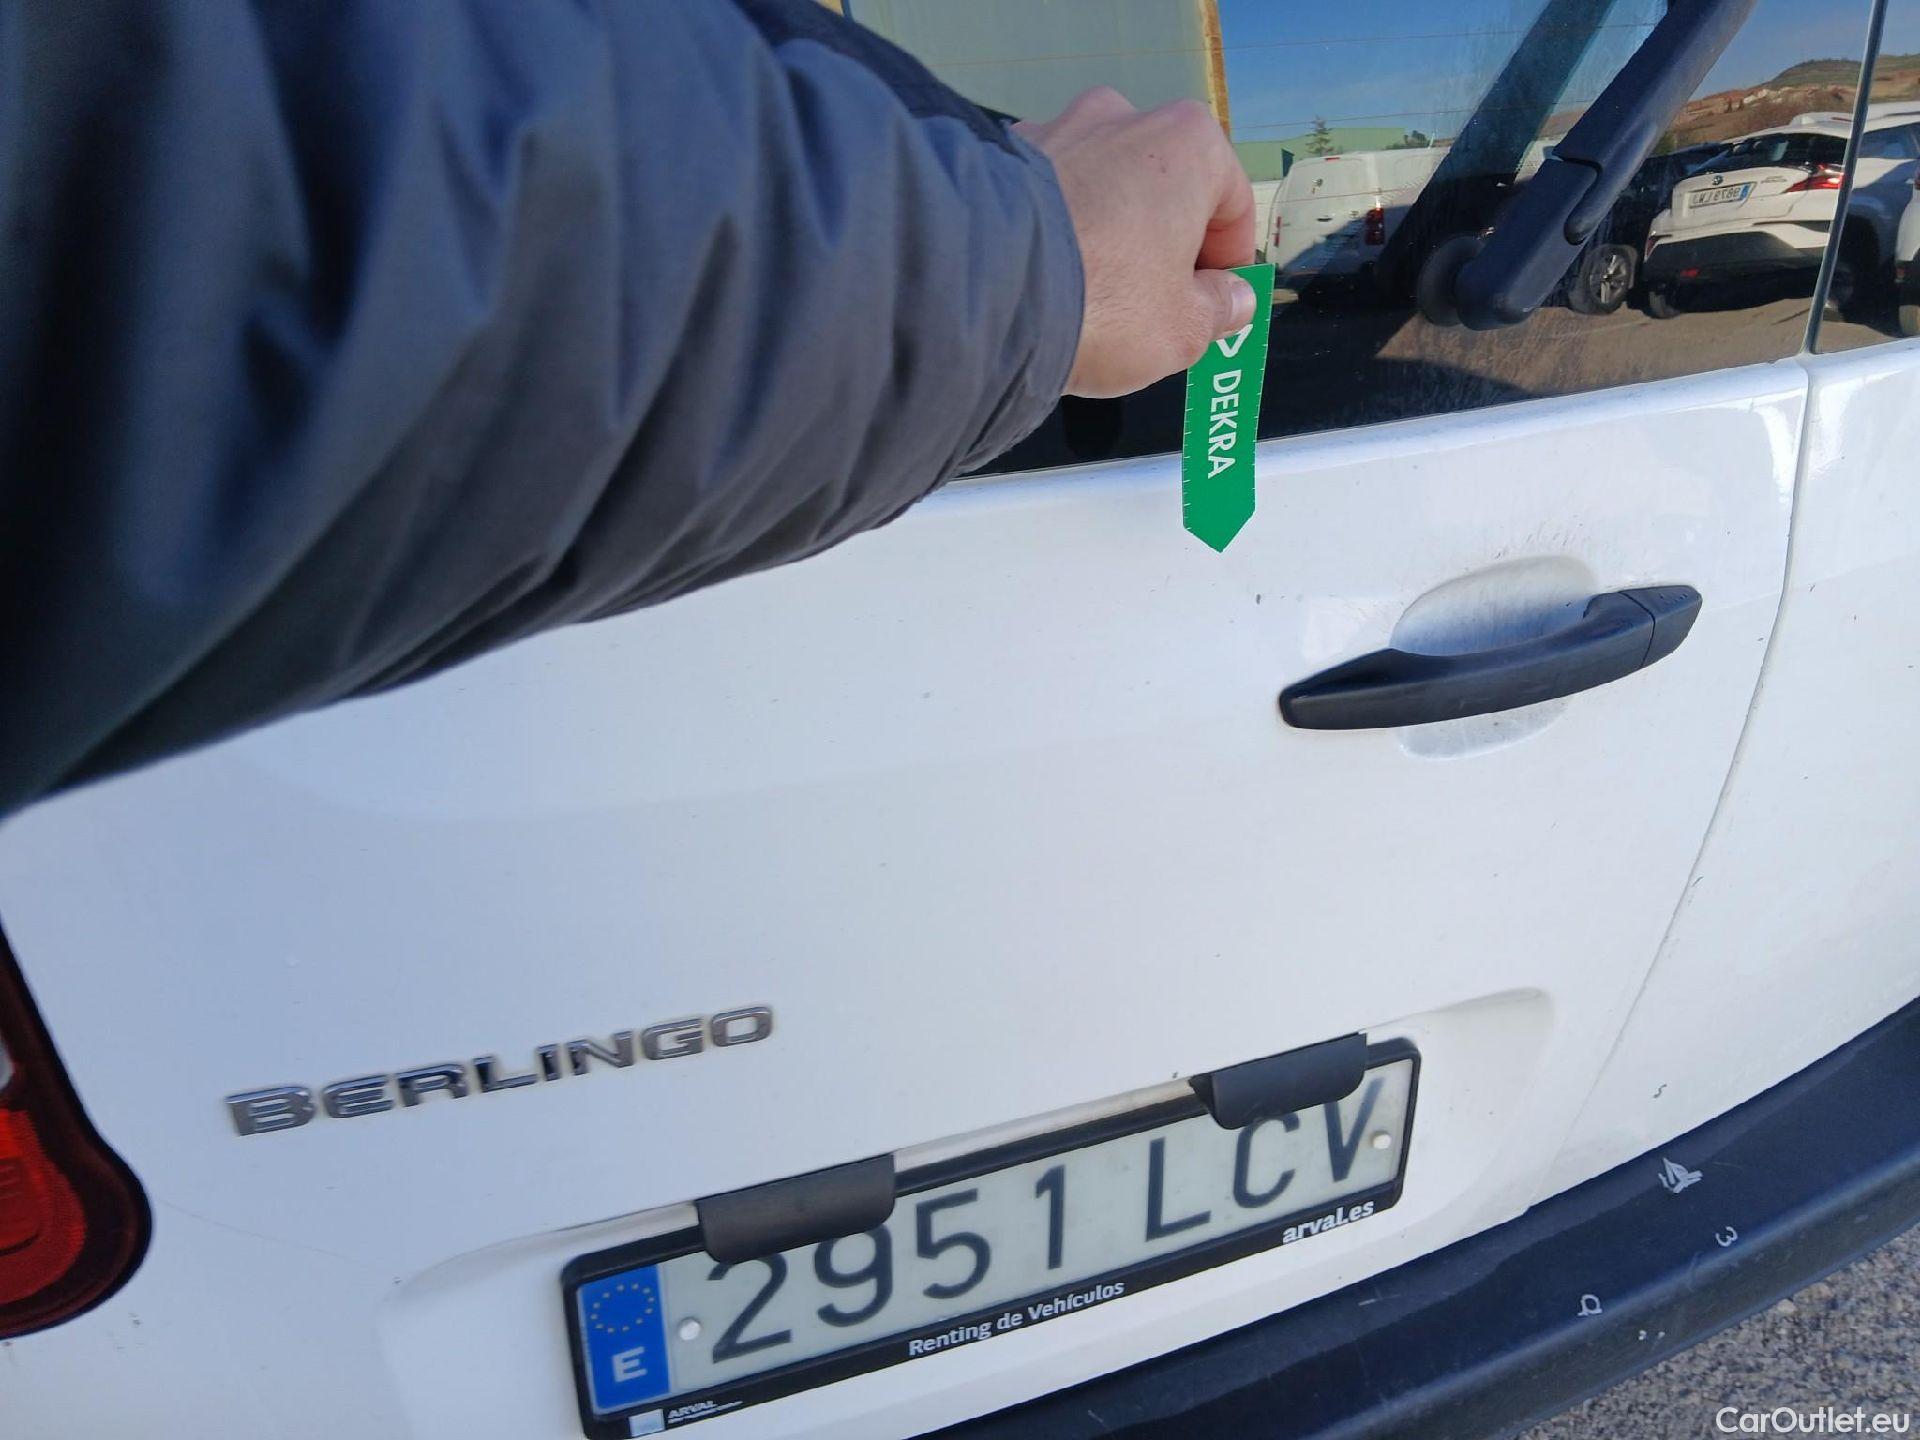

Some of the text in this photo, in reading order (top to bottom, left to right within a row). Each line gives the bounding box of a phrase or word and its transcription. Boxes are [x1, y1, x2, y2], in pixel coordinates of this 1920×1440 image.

[1208, 369, 1242, 479] DEKRA
[226, 1003, 773, 1137] BERLINGO
[707, 1077, 1386, 1364] 2951 LCV
[1282, 1200, 1375, 1245] arval.es
[612, 1346, 648, 1383] E
[908, 1282, 1125, 1356] Renting de Vehículos
